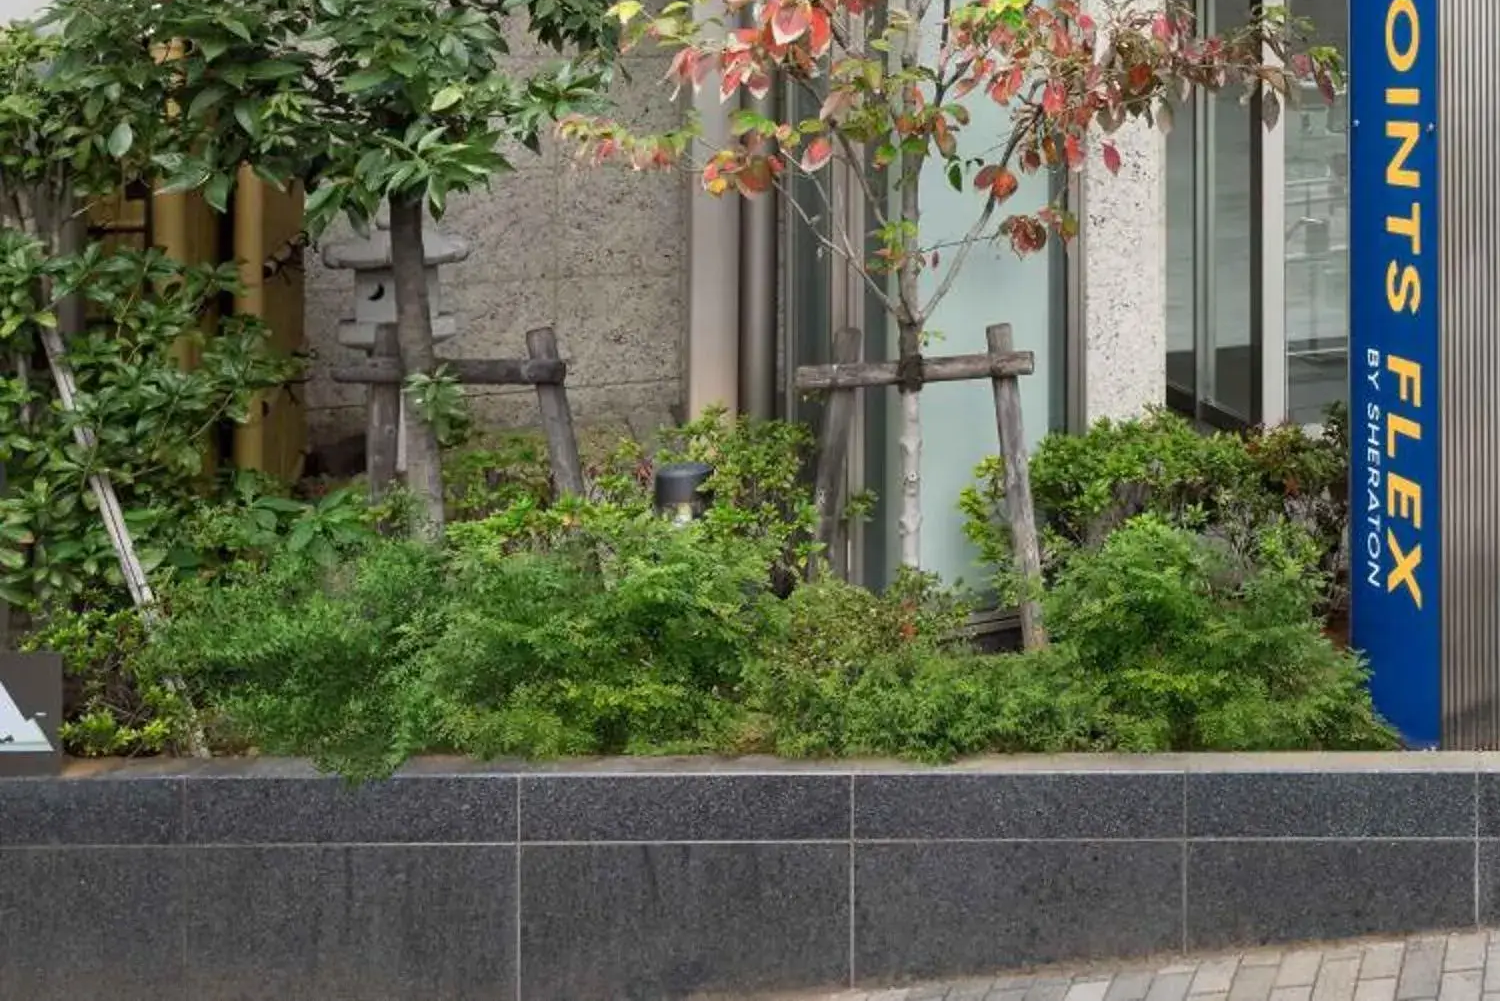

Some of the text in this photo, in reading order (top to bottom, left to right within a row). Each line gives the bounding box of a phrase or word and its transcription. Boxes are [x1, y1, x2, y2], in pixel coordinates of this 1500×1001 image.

[1366, 347, 1381, 587] BY SHERATON
[1387, 354, 1422, 610] FLEX
